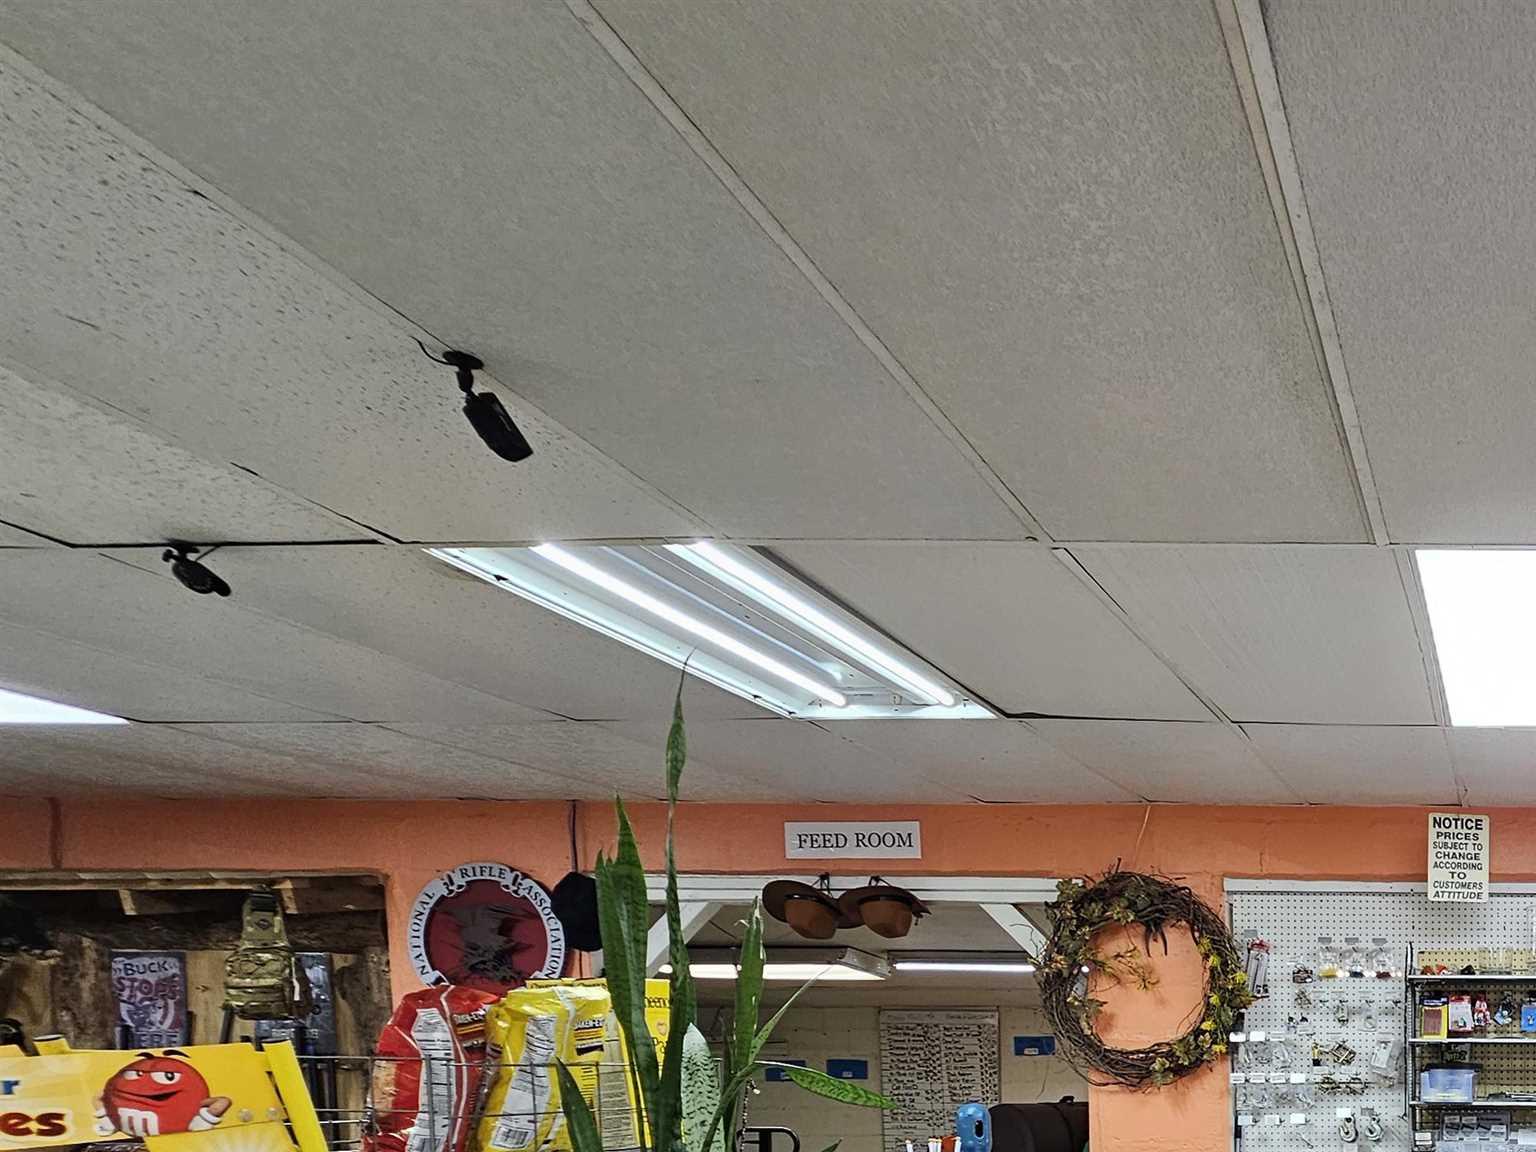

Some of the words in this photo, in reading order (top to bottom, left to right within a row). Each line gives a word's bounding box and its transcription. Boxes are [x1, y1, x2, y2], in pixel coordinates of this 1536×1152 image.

[1432, 816, 1483, 830] NOTICE
[797, 832, 848, 849] FEED
[854, 832, 914, 848] ROOM
[1436, 832, 1480, 841] PRICES
[1432, 841, 1468, 851] SUBJECT
[1472, 842, 1483, 851] TO
[1435, 851, 1480, 861] CHANGE
[1432, 861, 1483, 871] ACCORDING
[1449, 872, 1467, 880] TO
[1432, 880, 1483, 890] CUSTOMERS
[1432, 890, 1483, 900] ATTITUDE
[410, 890, 436, 976] NATIONAL
[459, 865, 507, 880] RIFLE
[123, 961, 168, 976] BUCK
